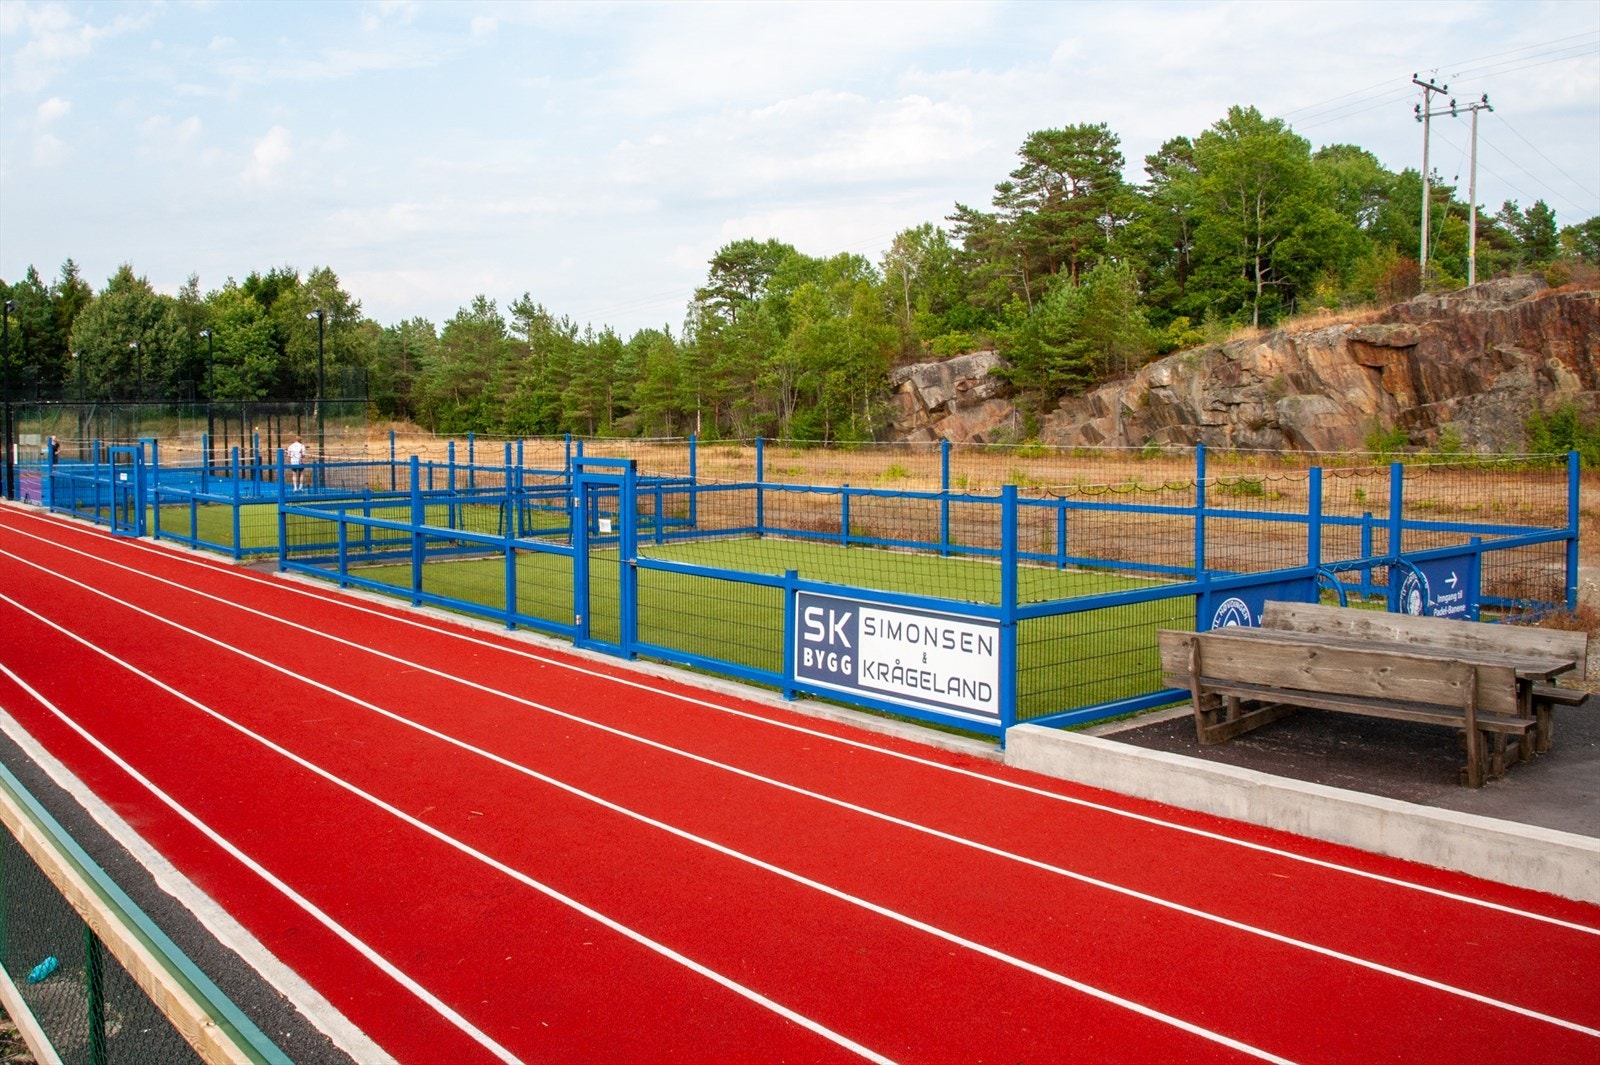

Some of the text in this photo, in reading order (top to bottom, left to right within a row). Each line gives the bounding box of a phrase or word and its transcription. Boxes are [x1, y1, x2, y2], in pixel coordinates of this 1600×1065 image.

[1437, 593, 1457, 604] Inngang
[804, 606, 852, 648] SK
[864, 616, 993, 657] SIMONSEN
[803, 648, 852, 676] BYGG
[922, 651, 928, 664] &
[863, 658, 993, 703] KRÅGELAND
